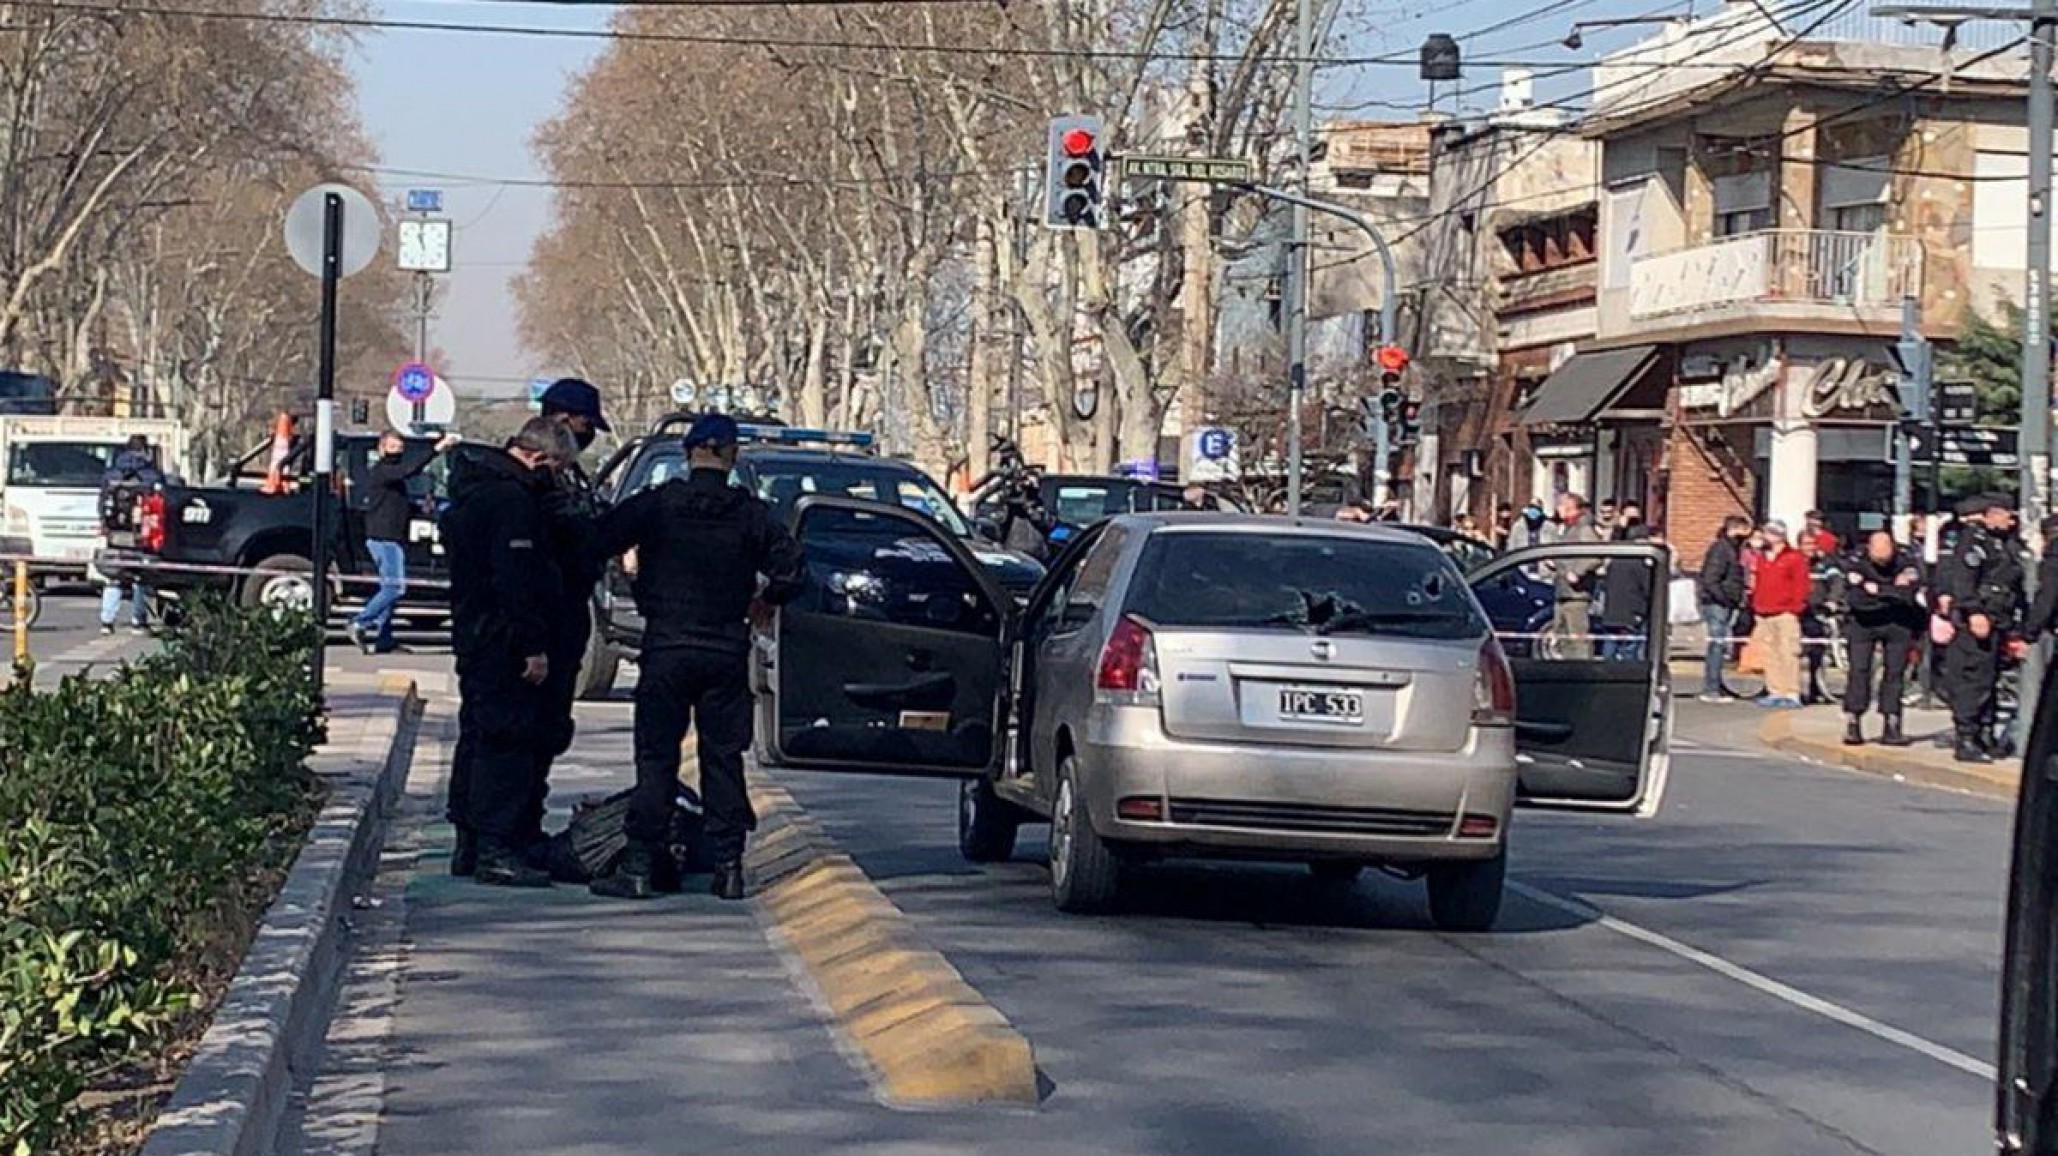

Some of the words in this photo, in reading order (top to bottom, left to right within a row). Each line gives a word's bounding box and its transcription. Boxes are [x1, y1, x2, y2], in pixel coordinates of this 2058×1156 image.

[1206, 433, 1222, 454] E
[1283, 691, 1316, 713] IPC
[1325, 693, 1361, 715] 533
